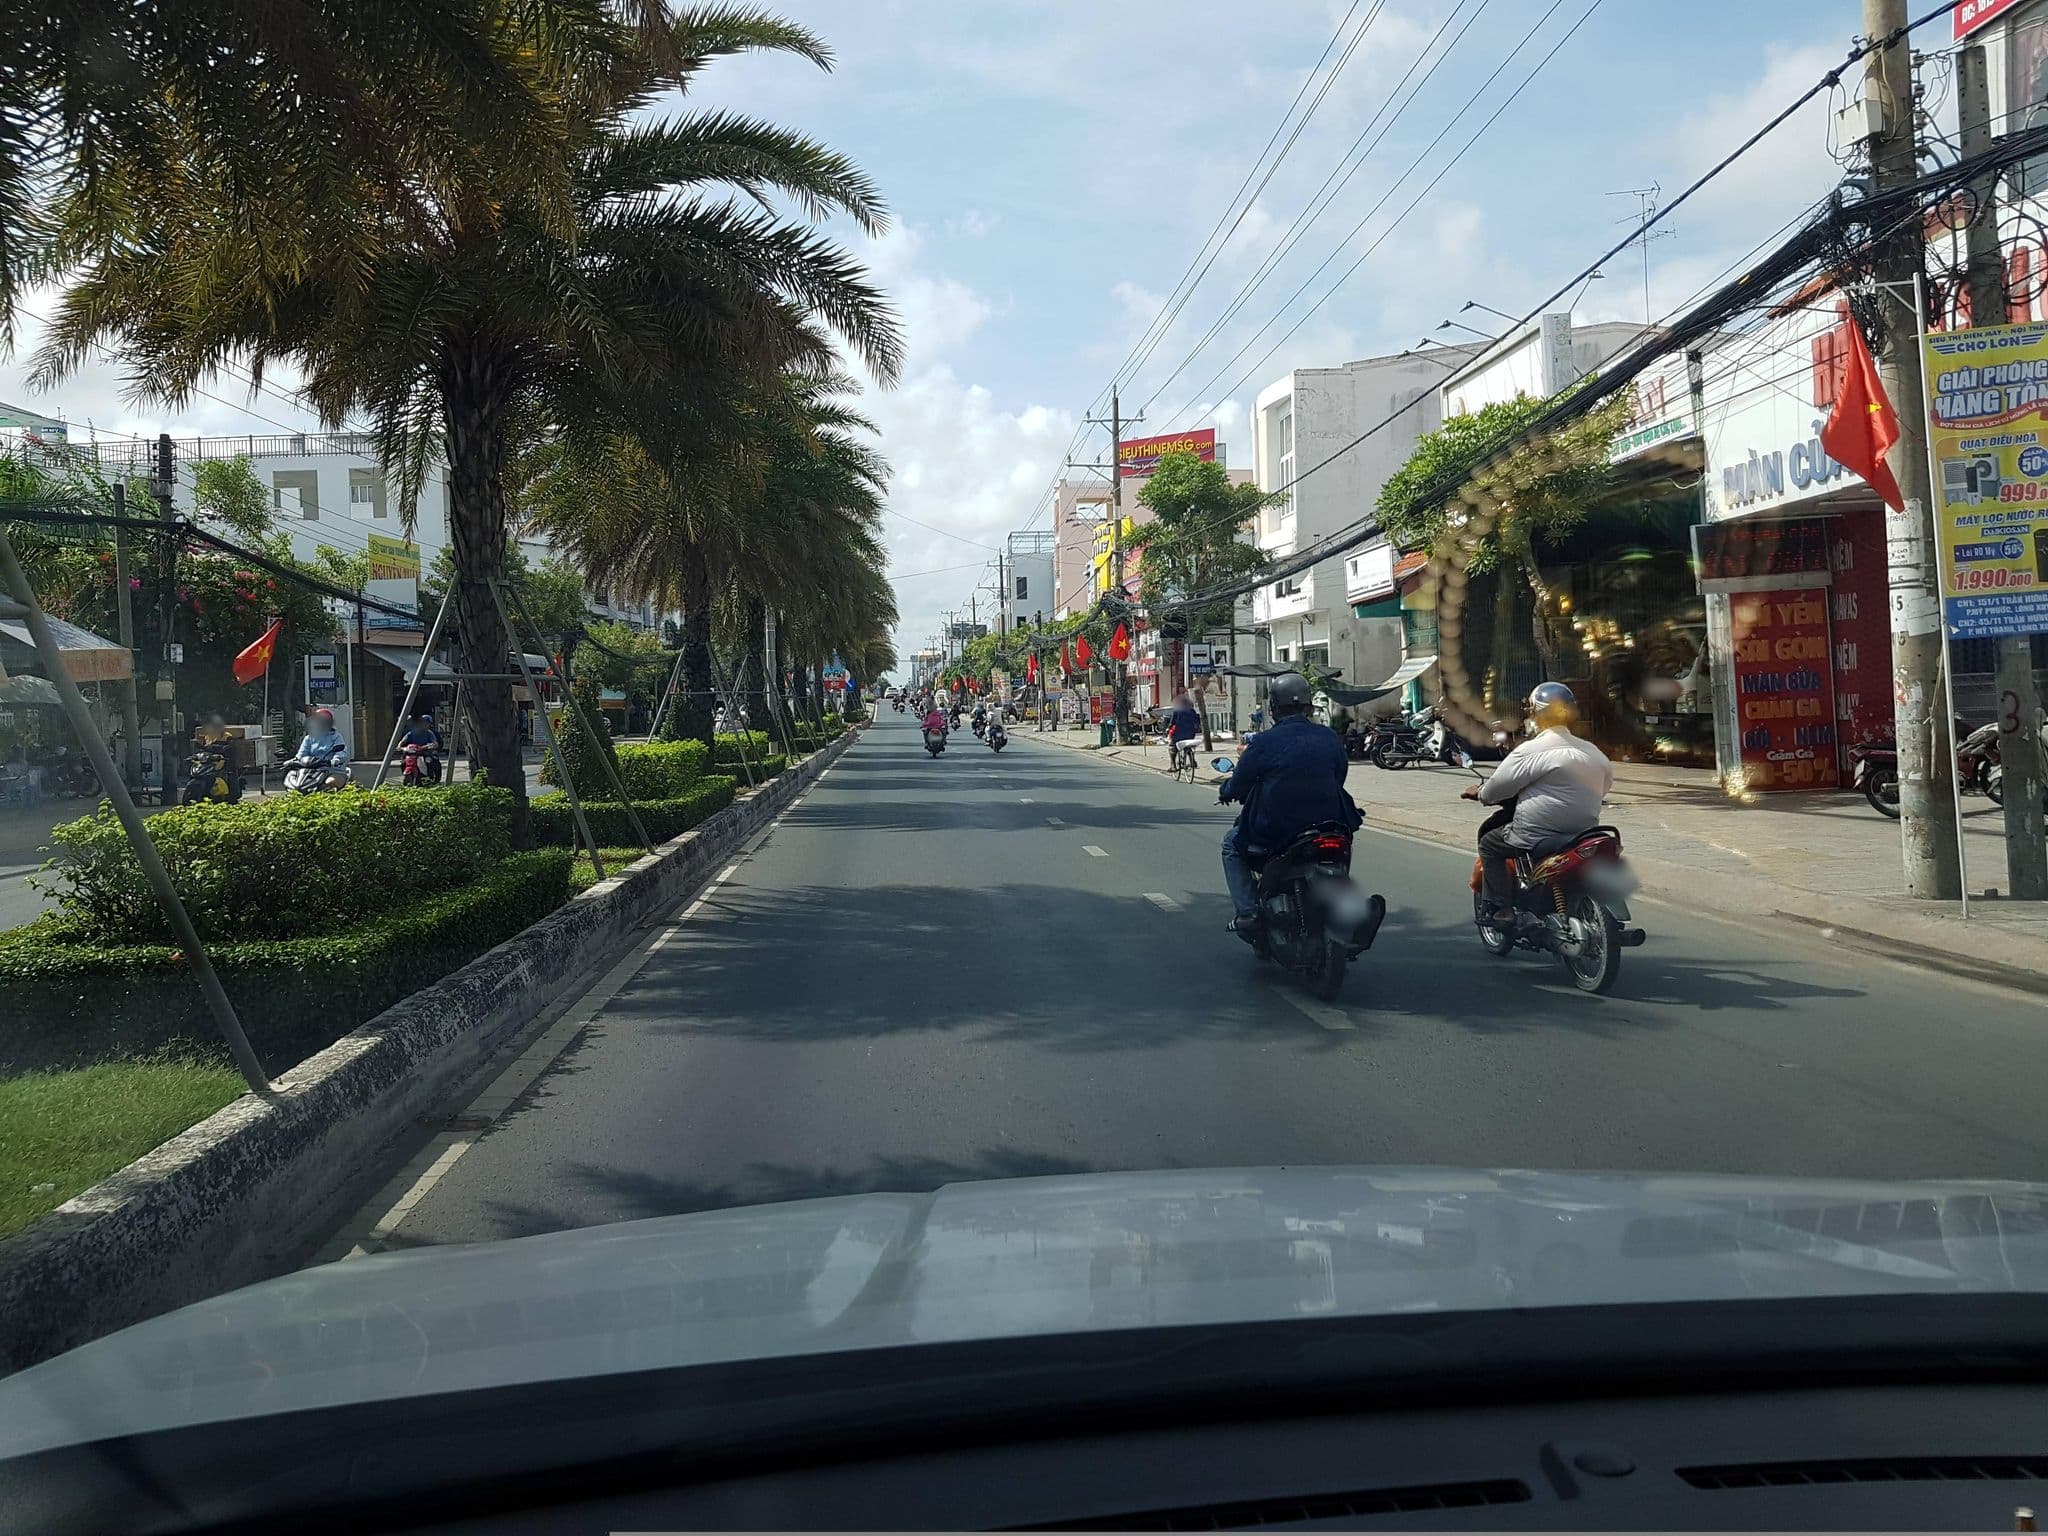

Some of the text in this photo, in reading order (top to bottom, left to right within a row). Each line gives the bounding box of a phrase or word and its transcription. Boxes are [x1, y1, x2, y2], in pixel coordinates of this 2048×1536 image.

[1939, 360, 2048, 392] GIẢI PHÓNG
[1935, 389, 2000, 418] HÀNG
[1724, 448, 1783, 506] MÀN
[1956, 568, 2032, 591] 1.990.000
